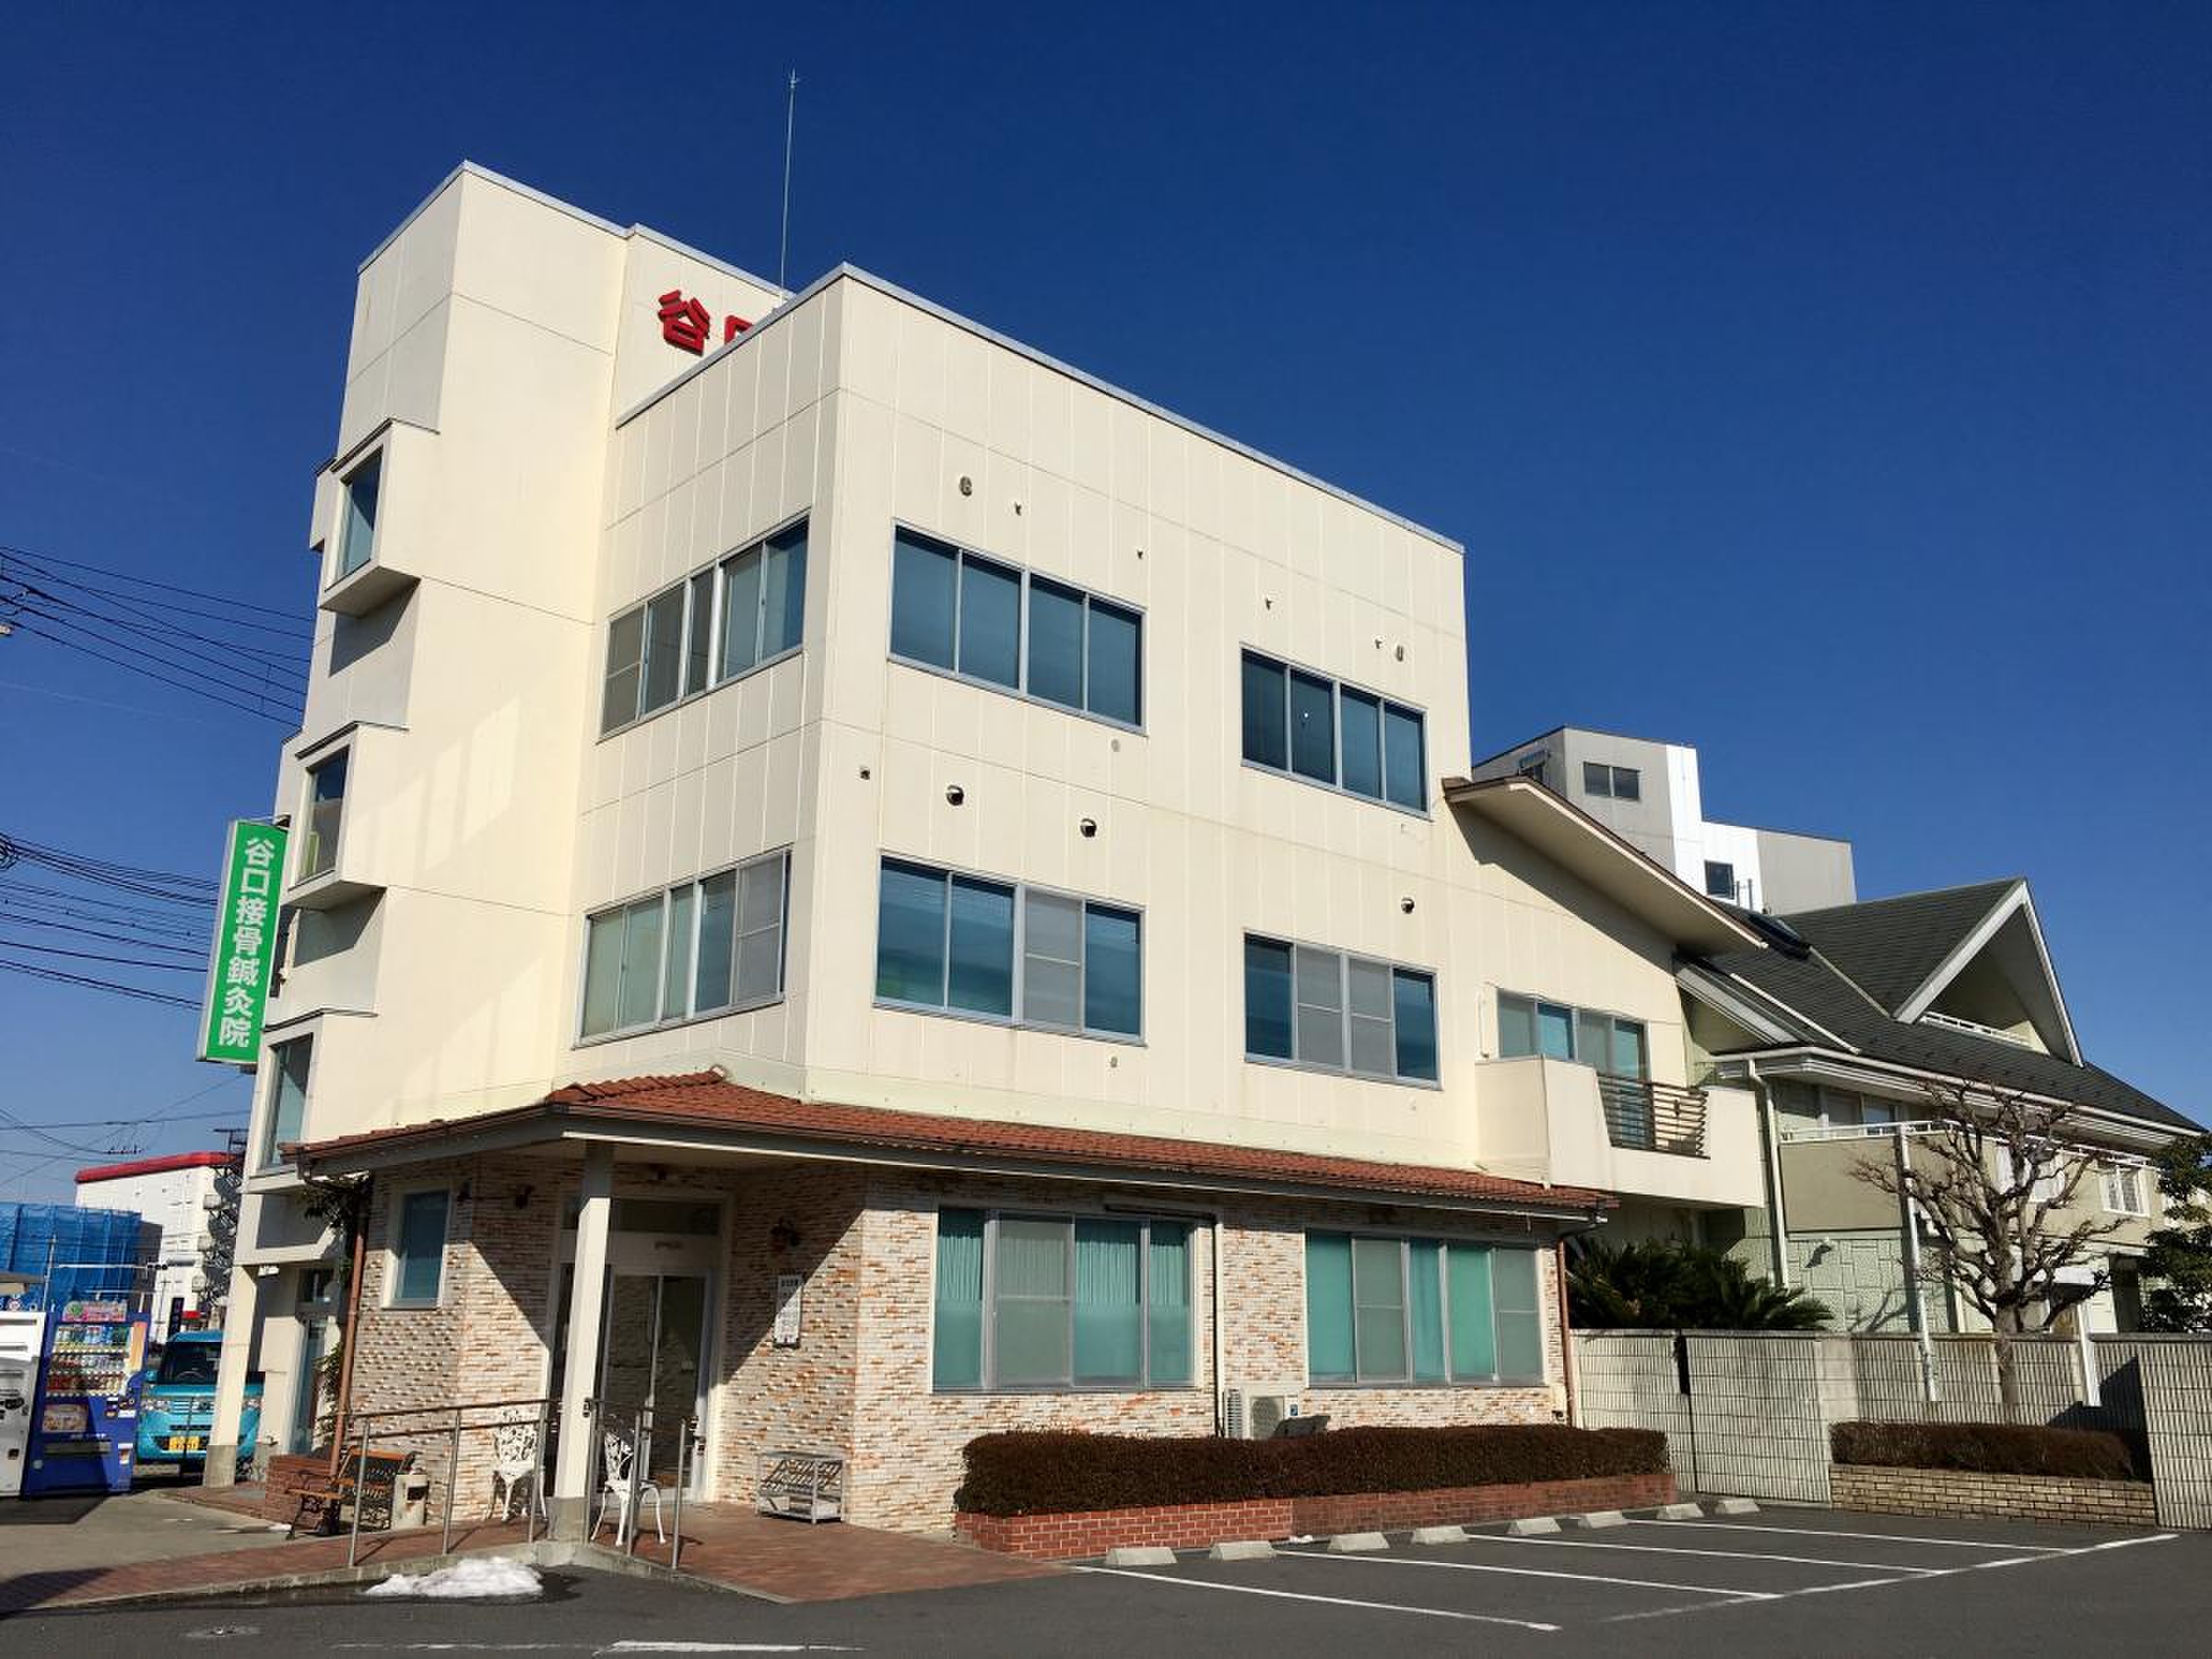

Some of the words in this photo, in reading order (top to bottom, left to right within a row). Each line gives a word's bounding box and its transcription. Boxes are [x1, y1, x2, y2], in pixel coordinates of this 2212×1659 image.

[218, 838, 276, 1048] 谷口接骨鍼灸院
